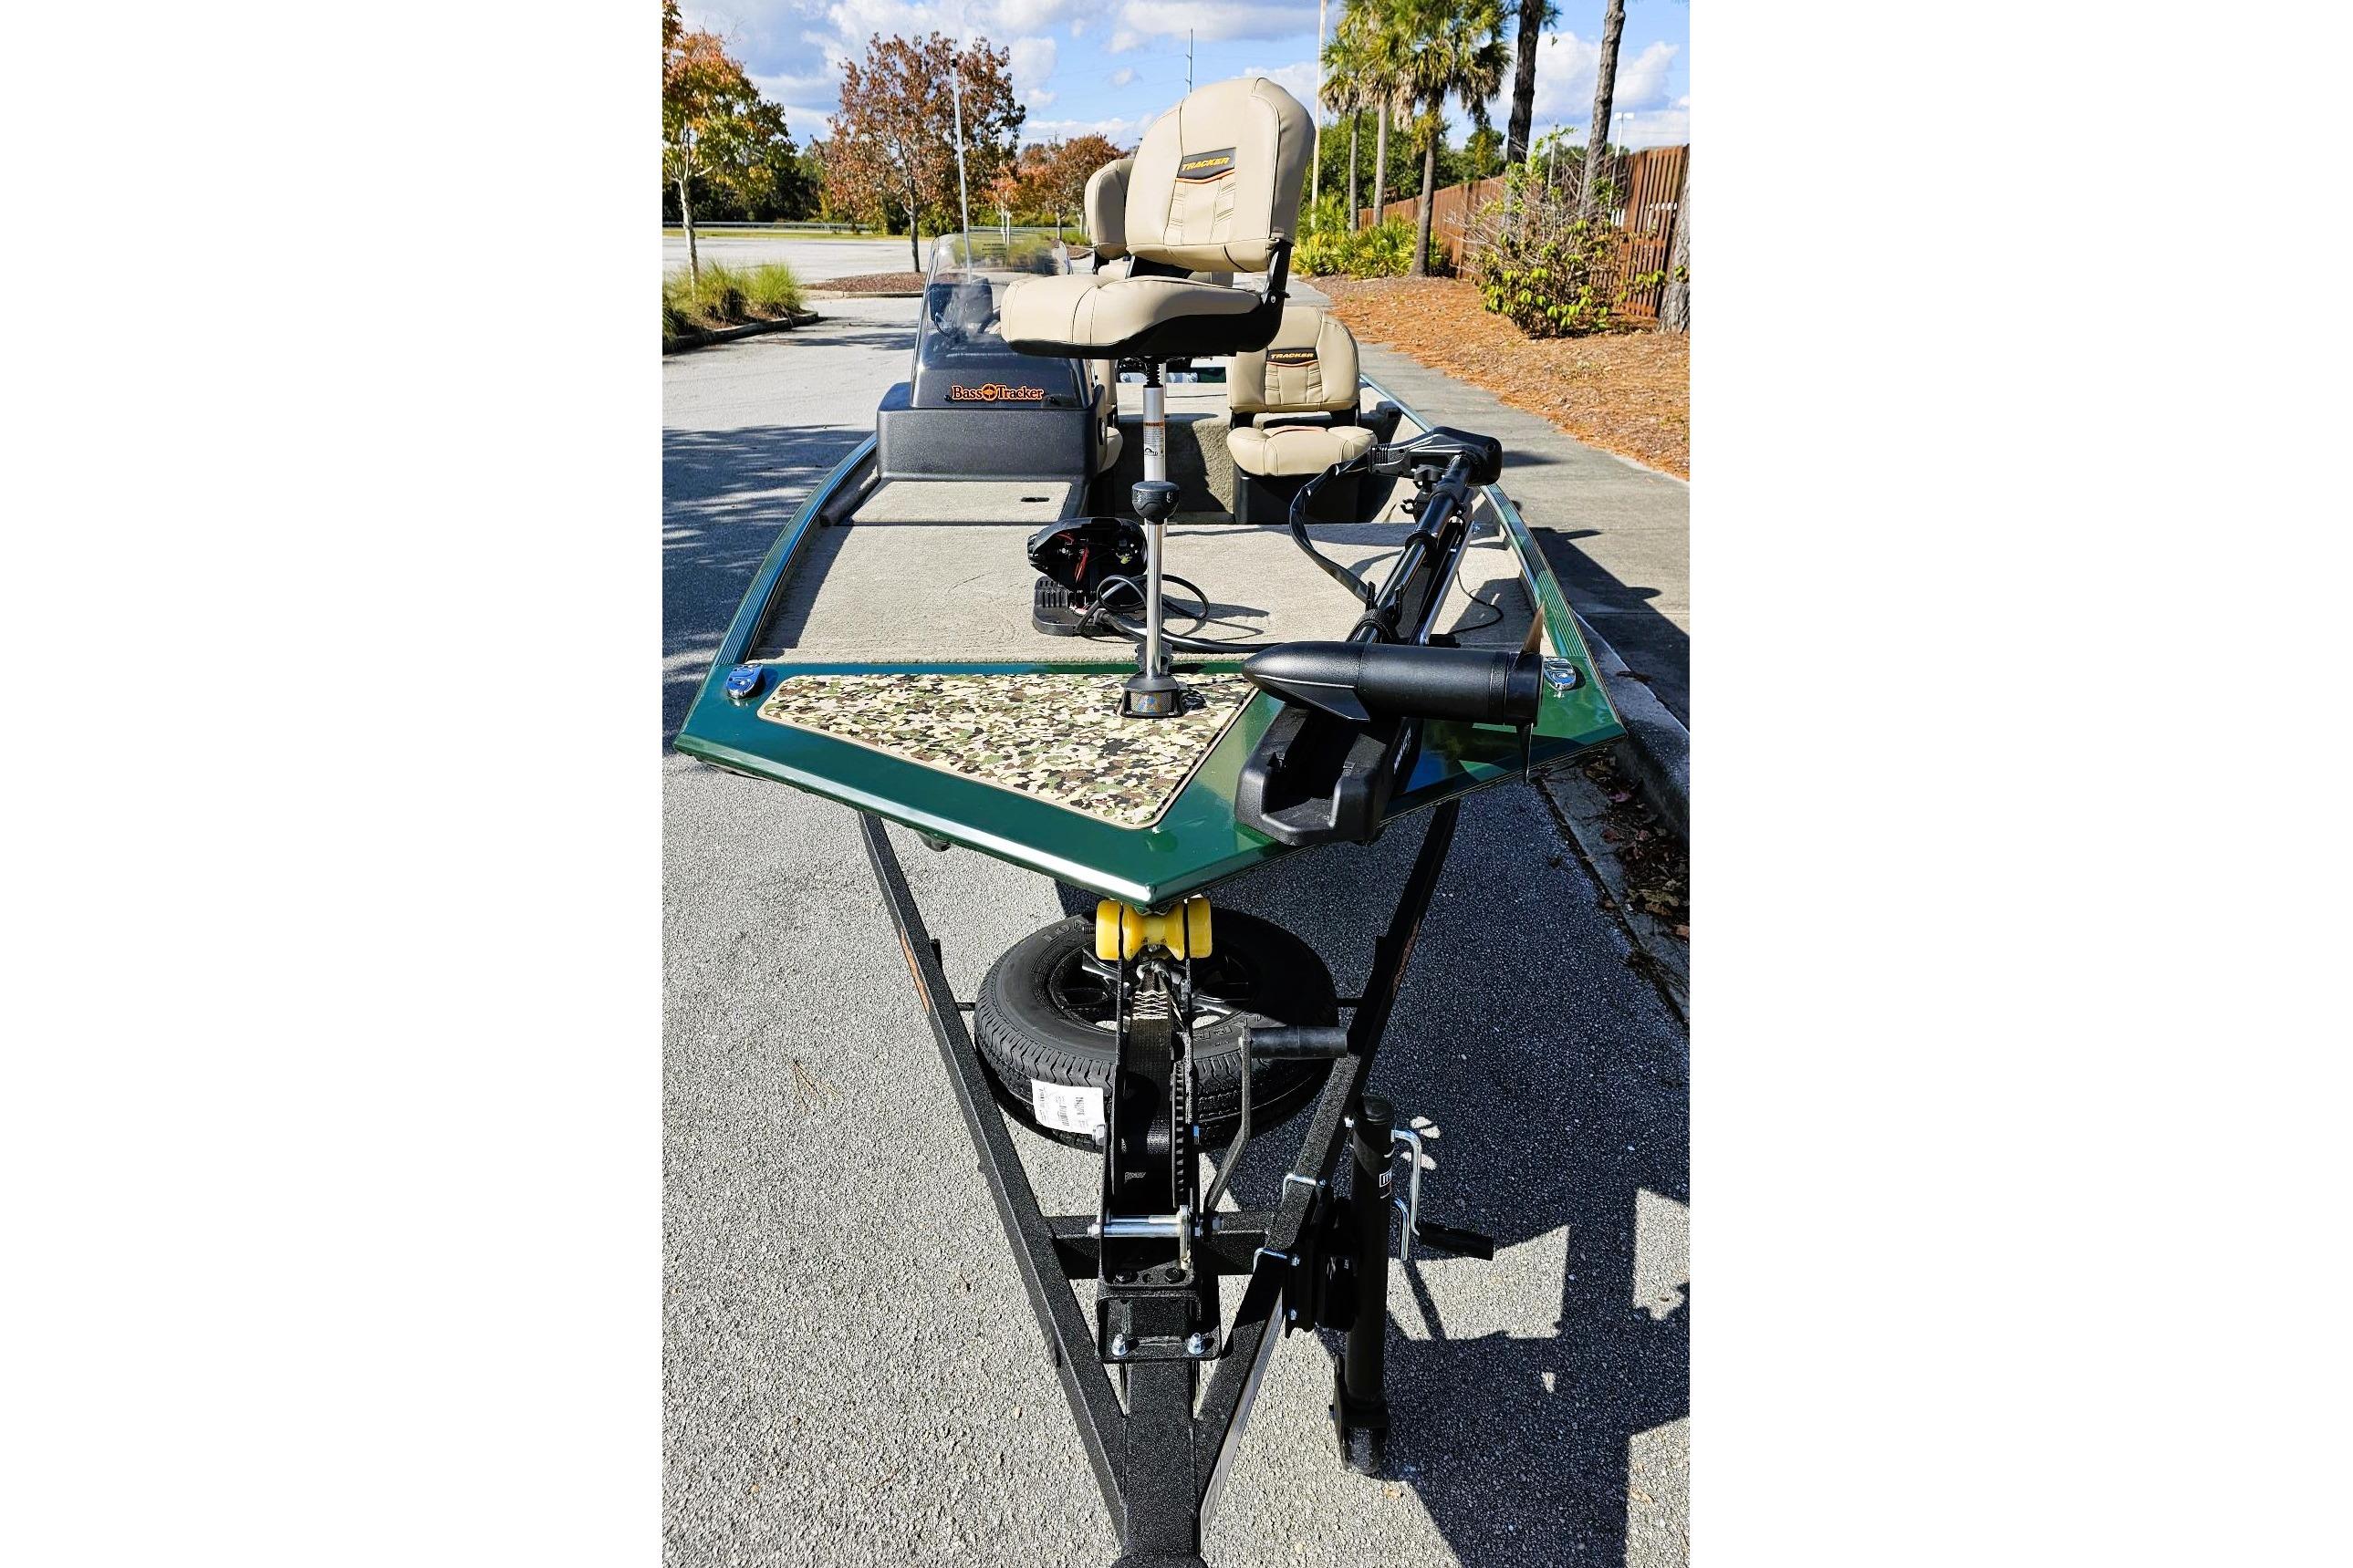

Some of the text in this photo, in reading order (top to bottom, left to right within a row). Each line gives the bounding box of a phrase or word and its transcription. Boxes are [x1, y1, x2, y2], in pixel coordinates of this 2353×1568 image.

[1182, 157, 1230, 171] TRACKER
[952, 385, 1044, 400] Bass Tracker
